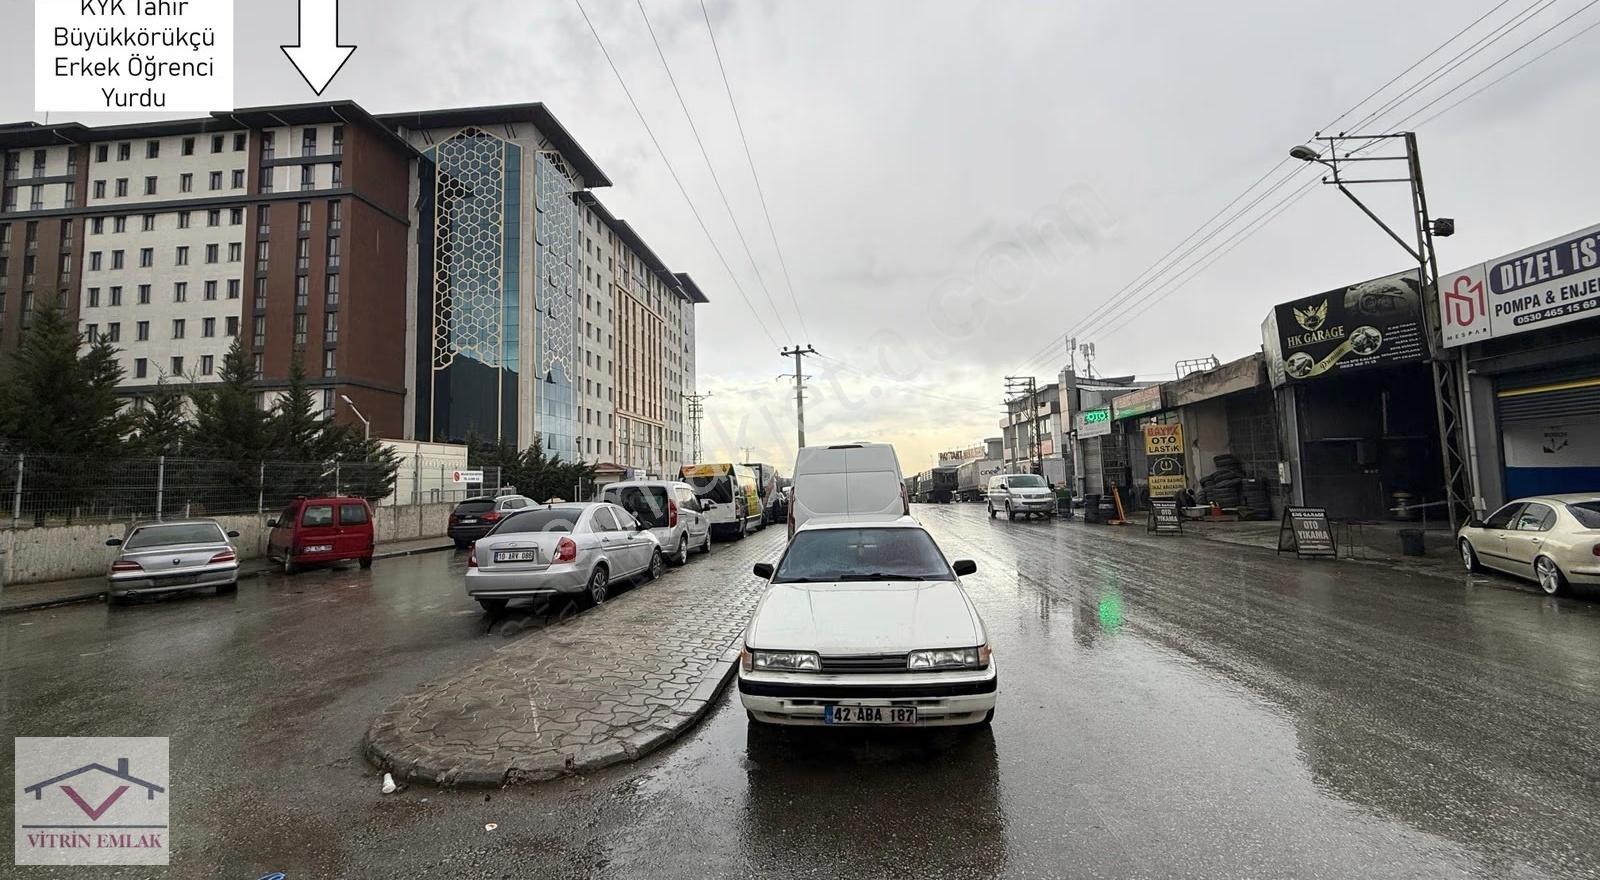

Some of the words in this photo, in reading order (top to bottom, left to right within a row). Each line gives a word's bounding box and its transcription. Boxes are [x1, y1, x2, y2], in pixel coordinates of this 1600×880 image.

[1571, 233, 1600, 270] iS
[1495, 293, 1541, 317] POMPA
[1545, 290, 1556, 304] &
[1560, 277, 1600, 301] ENJE
[1517, 312, 1542, 325] 0530
[1544, 307, 1564, 318] 465
[1566, 303, 1580, 313] 15
[1582, 299, 1597, 310] 69
[1287, 335, 1302, 347] HK
[1303, 325, 1345, 345] GARAGE
[1152, 436, 1177, 445] OTO
[834, 707, 851, 722] 42
[857, 707, 882, 722] ABA
[890, 708, 914, 722] 187
